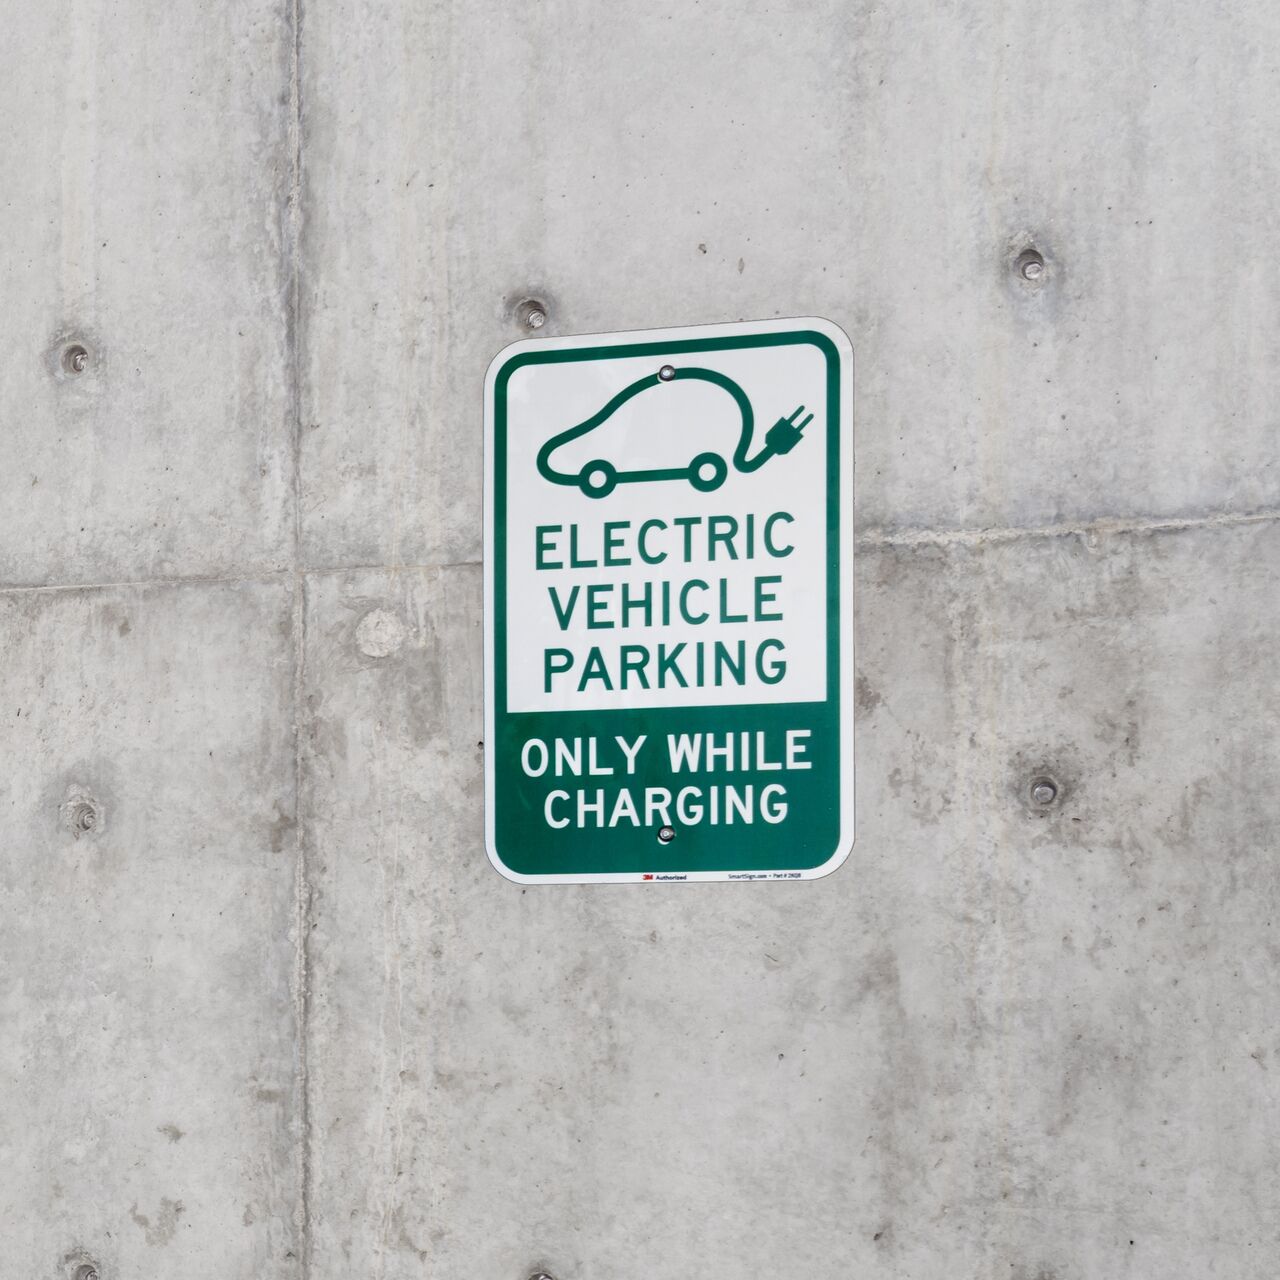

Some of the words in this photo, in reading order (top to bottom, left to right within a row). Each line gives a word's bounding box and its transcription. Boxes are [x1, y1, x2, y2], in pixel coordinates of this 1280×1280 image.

[536, 512, 794, 570] ELECTRIC
[548, 576, 783, 630] VEHICLE
[544, 639, 786, 693] PARKING
[521, 735, 647, 777] ONLY
[667, 730, 812, 773] WHILE
[545, 784, 787, 829] CHARGING
